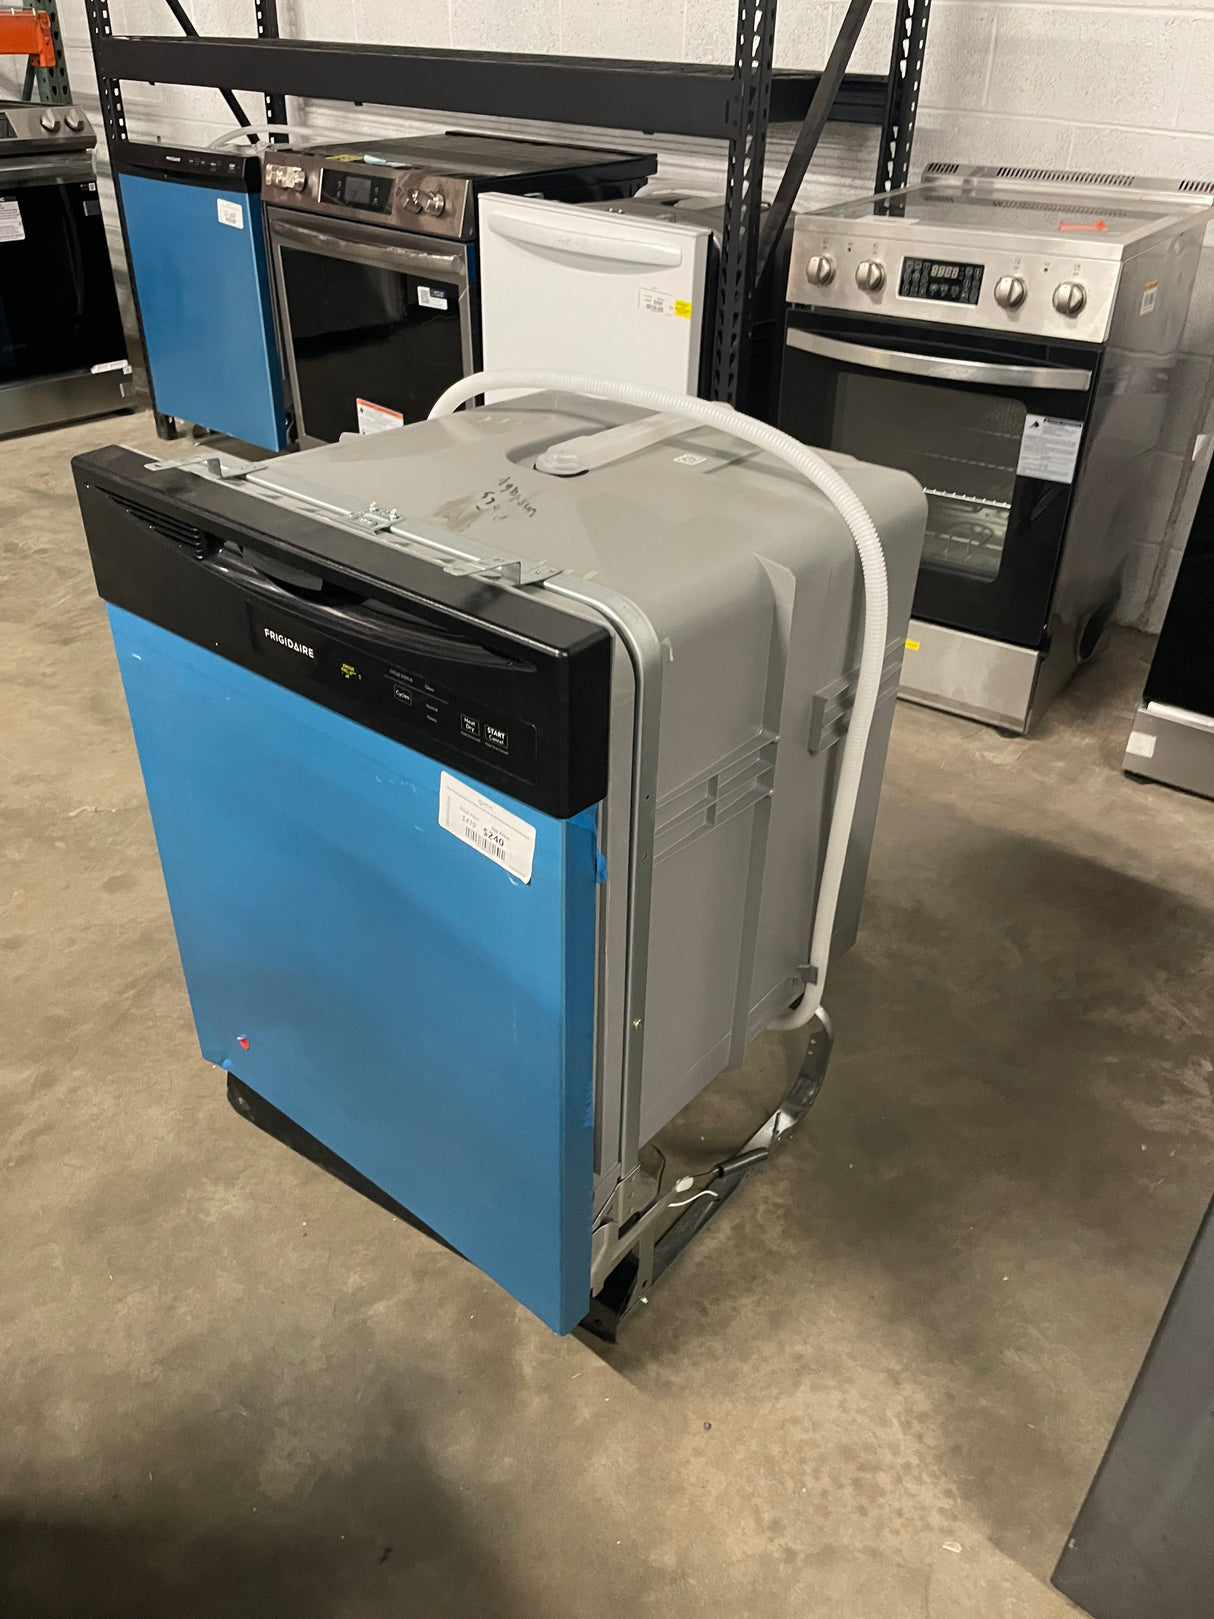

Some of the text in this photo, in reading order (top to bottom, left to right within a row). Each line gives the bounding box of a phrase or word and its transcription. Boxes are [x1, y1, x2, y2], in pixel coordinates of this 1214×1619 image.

[264, 628, 315, 659] FRIGIDAIRE
[487, 726, 505, 740] START
[483, 827, 505, 847] $240
